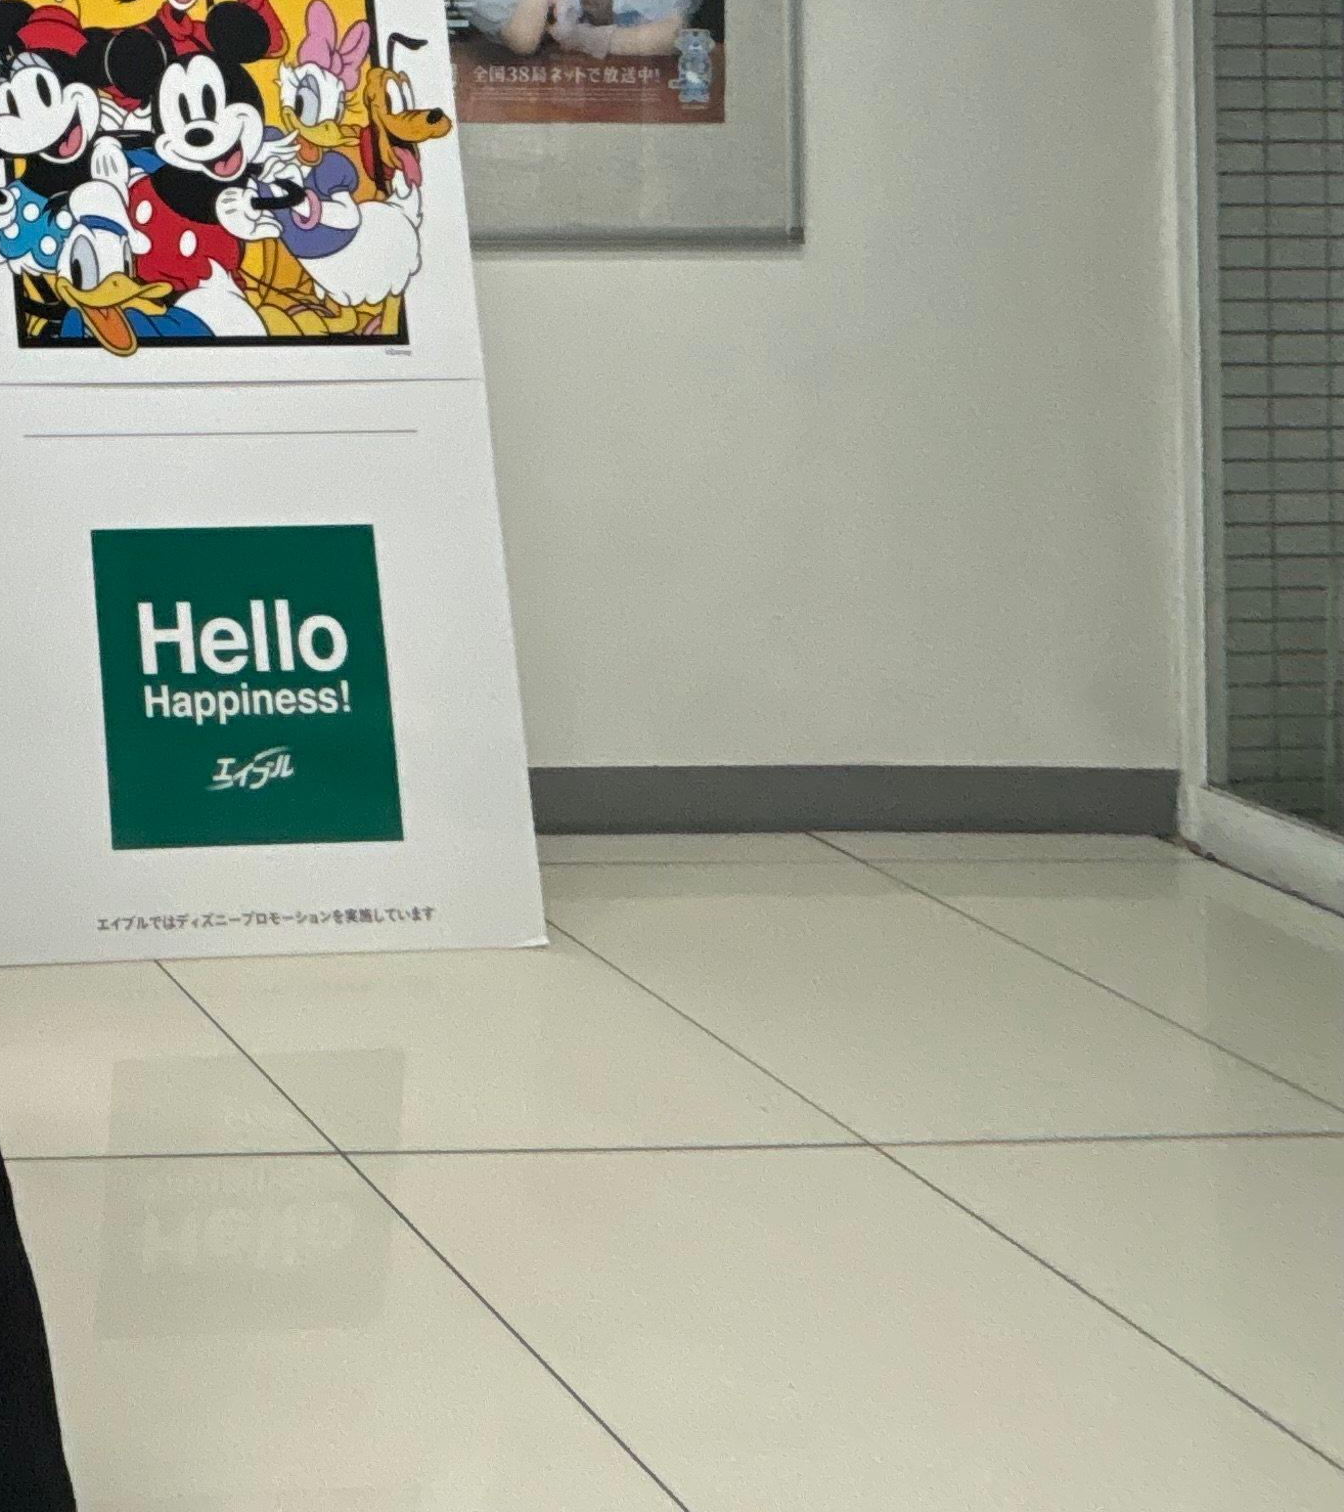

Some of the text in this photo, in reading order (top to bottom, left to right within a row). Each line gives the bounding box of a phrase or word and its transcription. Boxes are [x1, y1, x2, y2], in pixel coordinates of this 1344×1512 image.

[137, 599, 348, 675] Hello
[144, 680, 352, 725] Happiness!
[207, 746, 295, 791] エイブル
[96, 905, 435, 932] エイブルではディズニープロモーションを実施しています
